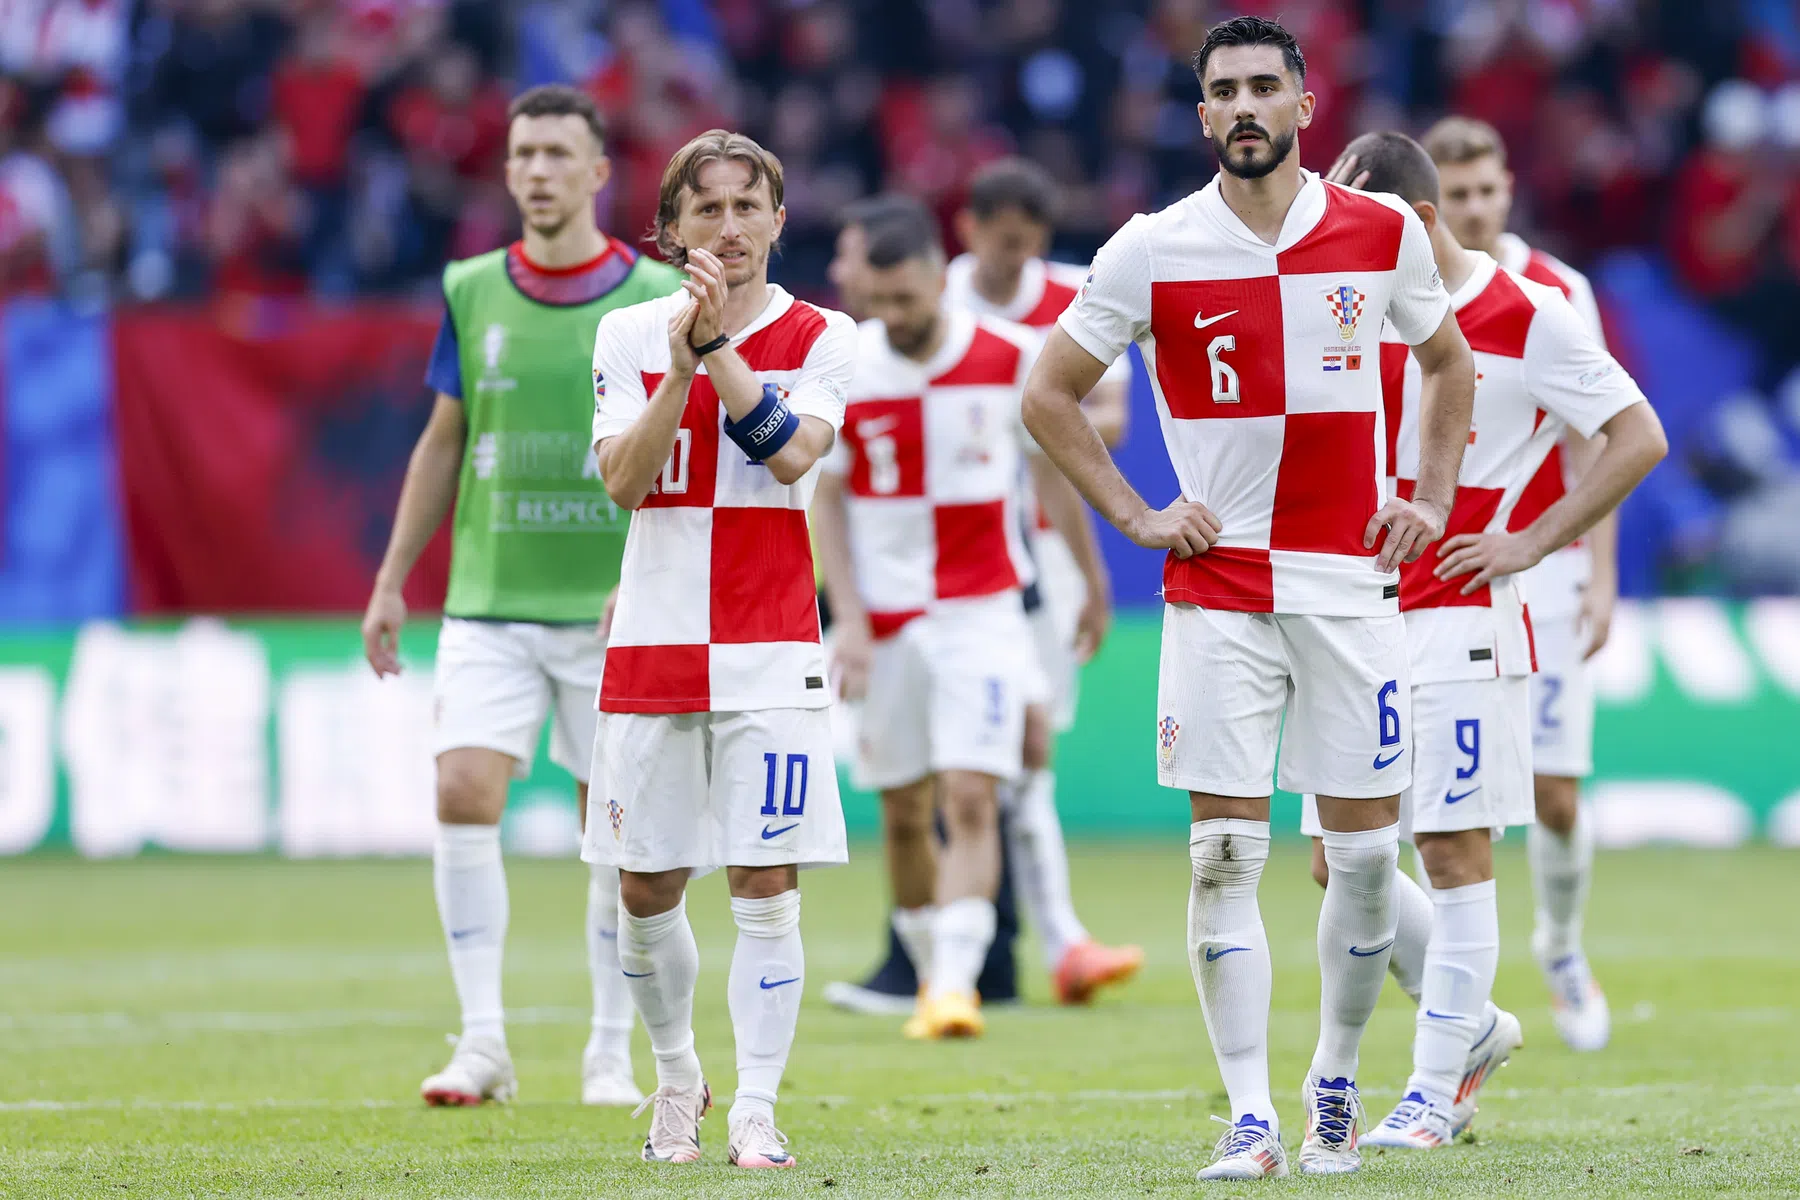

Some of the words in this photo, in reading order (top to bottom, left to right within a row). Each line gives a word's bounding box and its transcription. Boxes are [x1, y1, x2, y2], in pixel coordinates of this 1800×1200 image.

[1206, 335, 1240, 403] 6
[751, 408, 785, 443] RESPECT
[648, 428, 692, 495] 0
[1377, 679, 1400, 747] 6
[1455, 718, 1480, 779] 9
[760, 752, 808, 817] 10
